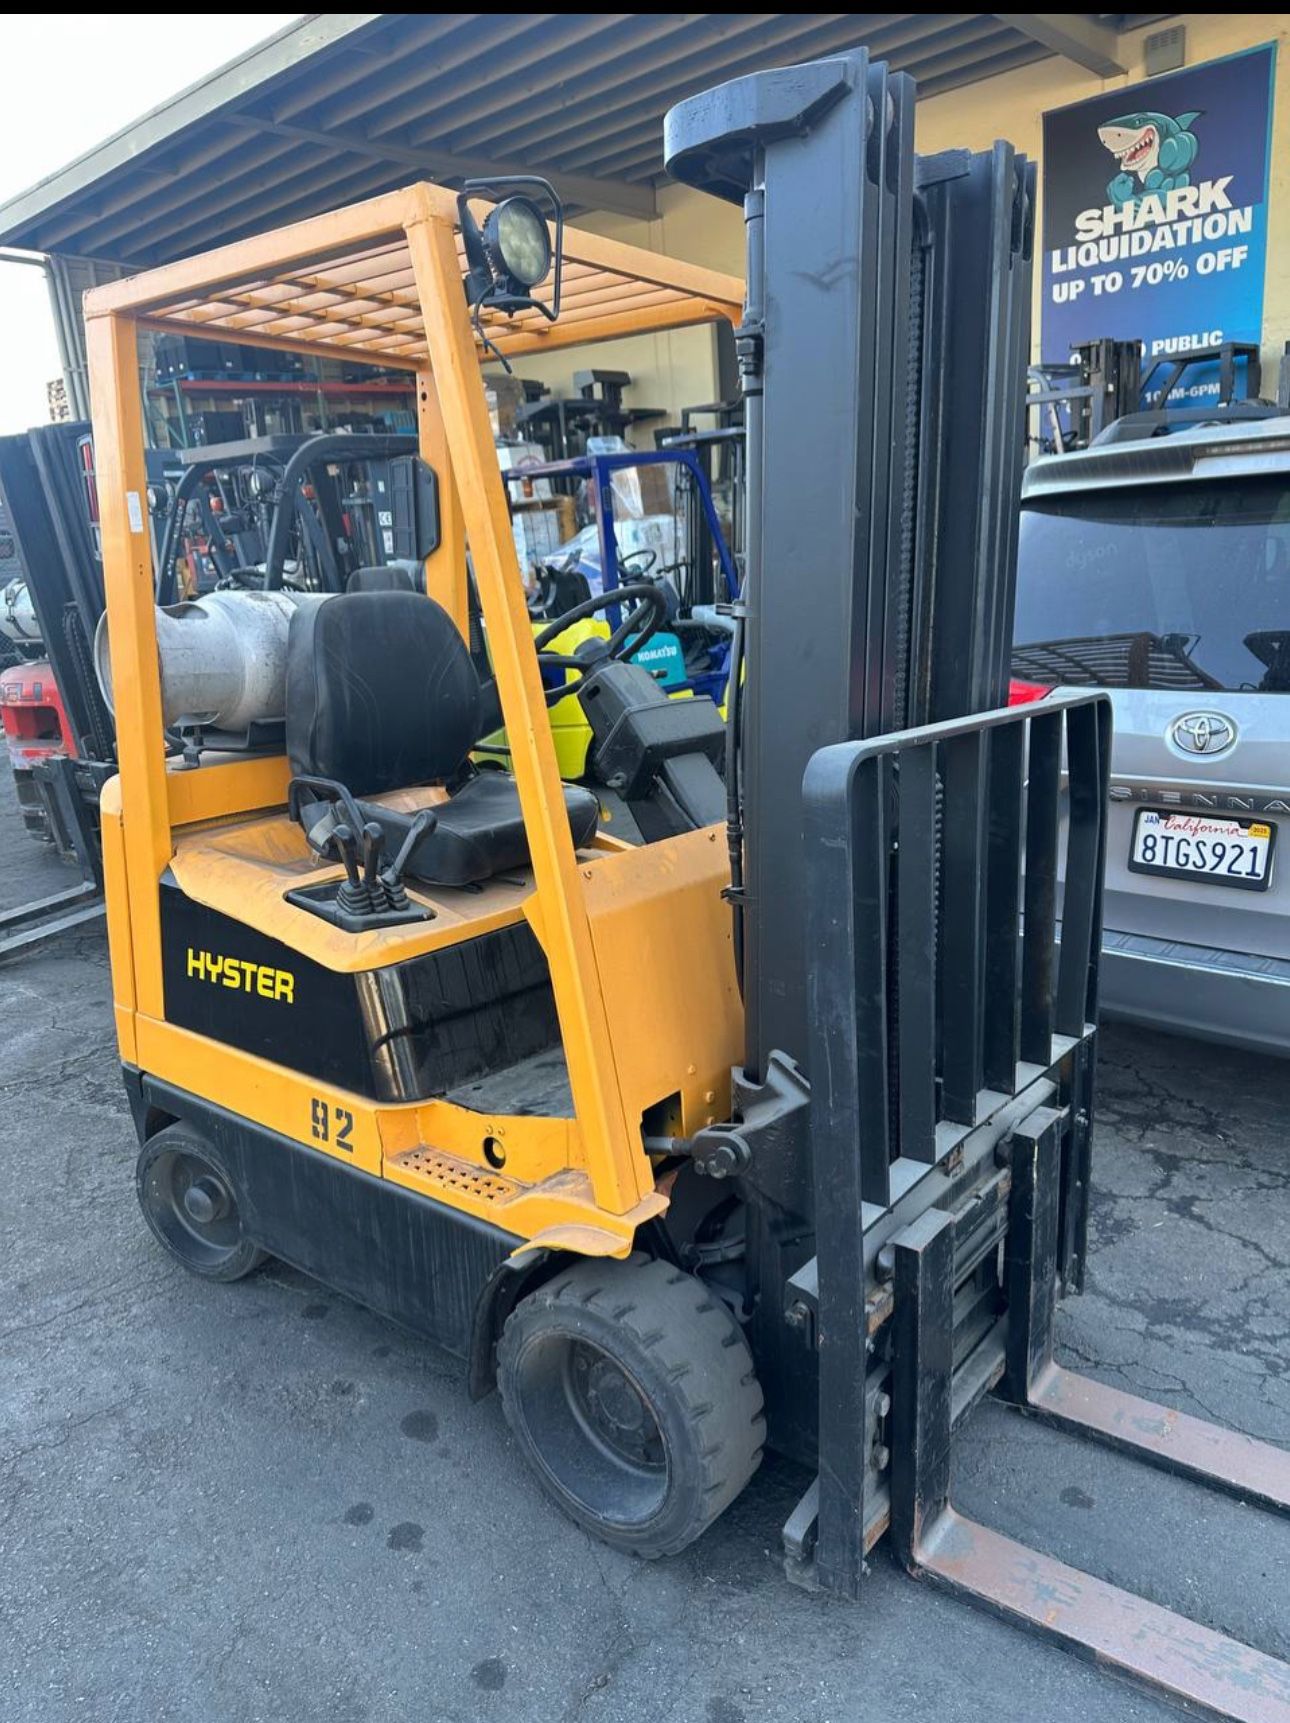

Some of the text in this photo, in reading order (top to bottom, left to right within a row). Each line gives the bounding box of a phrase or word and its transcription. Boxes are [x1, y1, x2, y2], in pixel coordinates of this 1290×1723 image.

[1075, 175, 1234, 242] SHARK
[1051, 206, 1253, 274] LIQUIDATION
[1052, 245, 1249, 304] UP TO 70% OFF
[1152, 330, 1223, 357] PUBLIC
[637, 645, 677, 662] KOMATSU
[1109, 786, 1290, 813] SIENNA
[1164, 814, 1241, 837] California
[1141, 834, 1262, 878] 8TGS921
[187, 947, 295, 1004] HYSTER
[311, 1097, 354, 1153] 92
